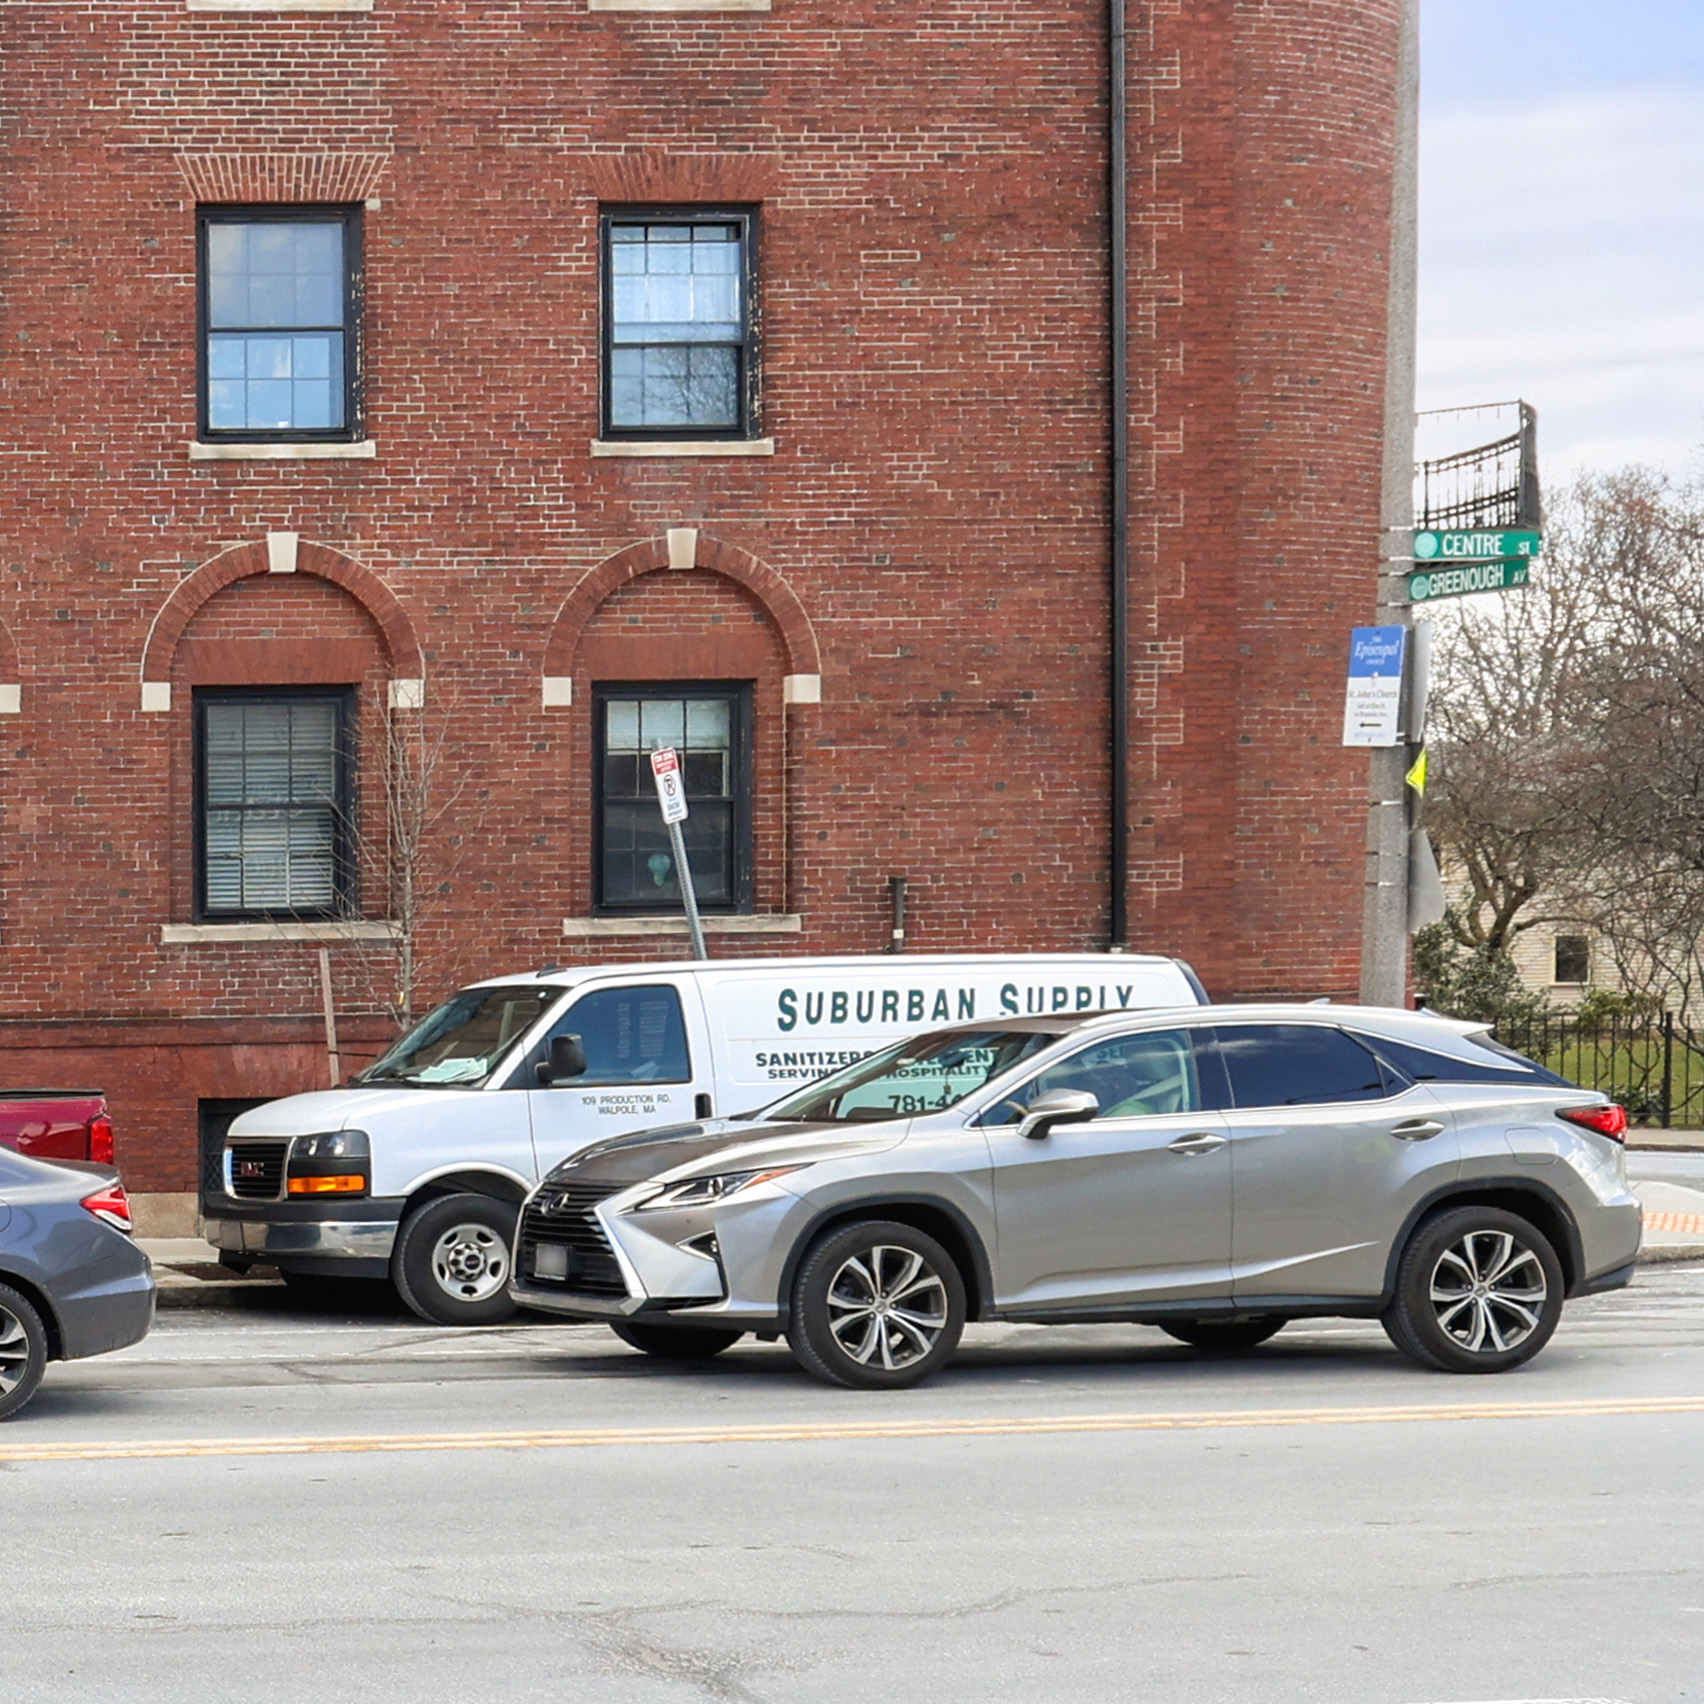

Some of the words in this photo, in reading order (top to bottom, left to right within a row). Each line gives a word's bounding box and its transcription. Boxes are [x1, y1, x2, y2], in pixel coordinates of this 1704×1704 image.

[1442, 534, 1504, 555] CENTRE
[1428, 563, 1504, 596] GREENOUGH
[1355, 640, 1400, 660] Episcopal
[777, 988, 976, 1032] SUBURBAN
[582, 1096, 596, 1105] 109
[600, 1095, 653, 1104] PRODUCTION
[658, 1094, 672, 1102] RD.
[598, 1105, 639, 1114] WALPOLE,
[643, 1105, 656, 1113] MA
